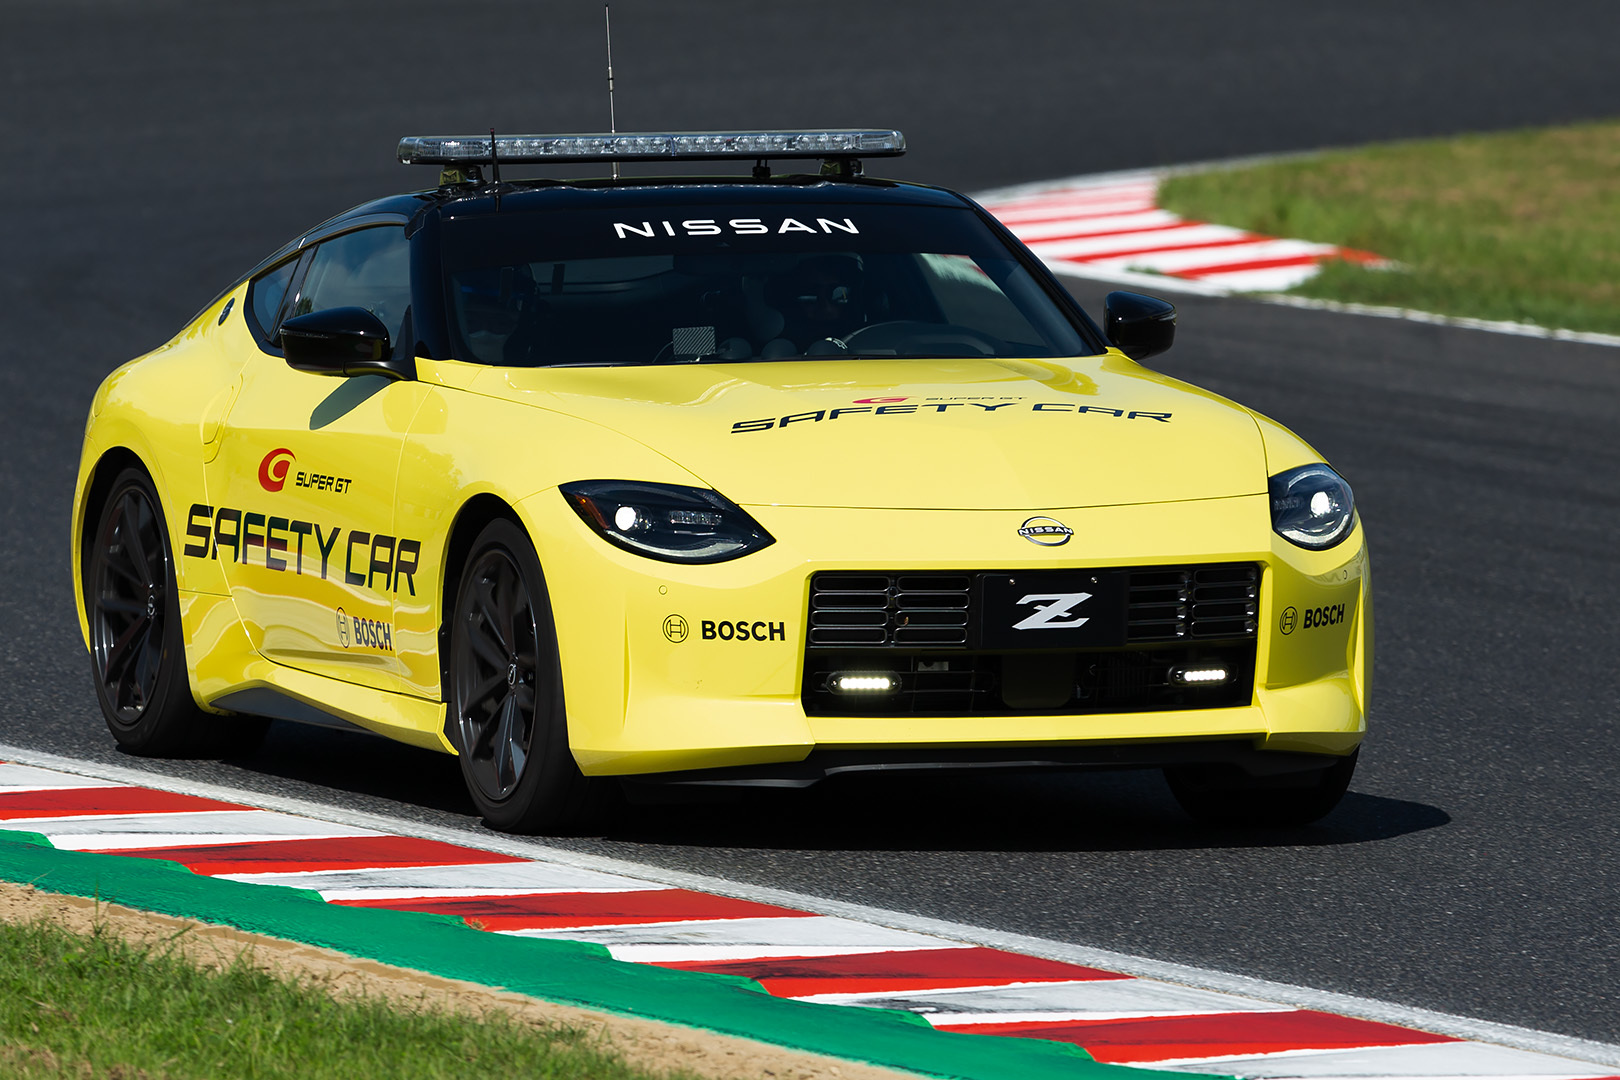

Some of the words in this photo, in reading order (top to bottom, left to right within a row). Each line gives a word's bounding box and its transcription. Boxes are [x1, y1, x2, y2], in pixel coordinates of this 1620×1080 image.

[613, 218, 860, 239] NISSAN
[731, 402, 1019, 434] SAFETY
[1032, 403, 1173, 423] CAR
[296, 471, 335, 492] SUPER
[335, 477, 352, 494] GT
[1018, 526, 1073, 535] NISSAN
[184, 503, 342, 580] SAFETY
[345, 530, 422, 597] CAR
[1012, 592, 1093, 630] Z
[1303, 603, 1345, 629] BOSCH
[353, 616, 393, 651] BOSCH
[701, 620, 786, 641] BOSCH
